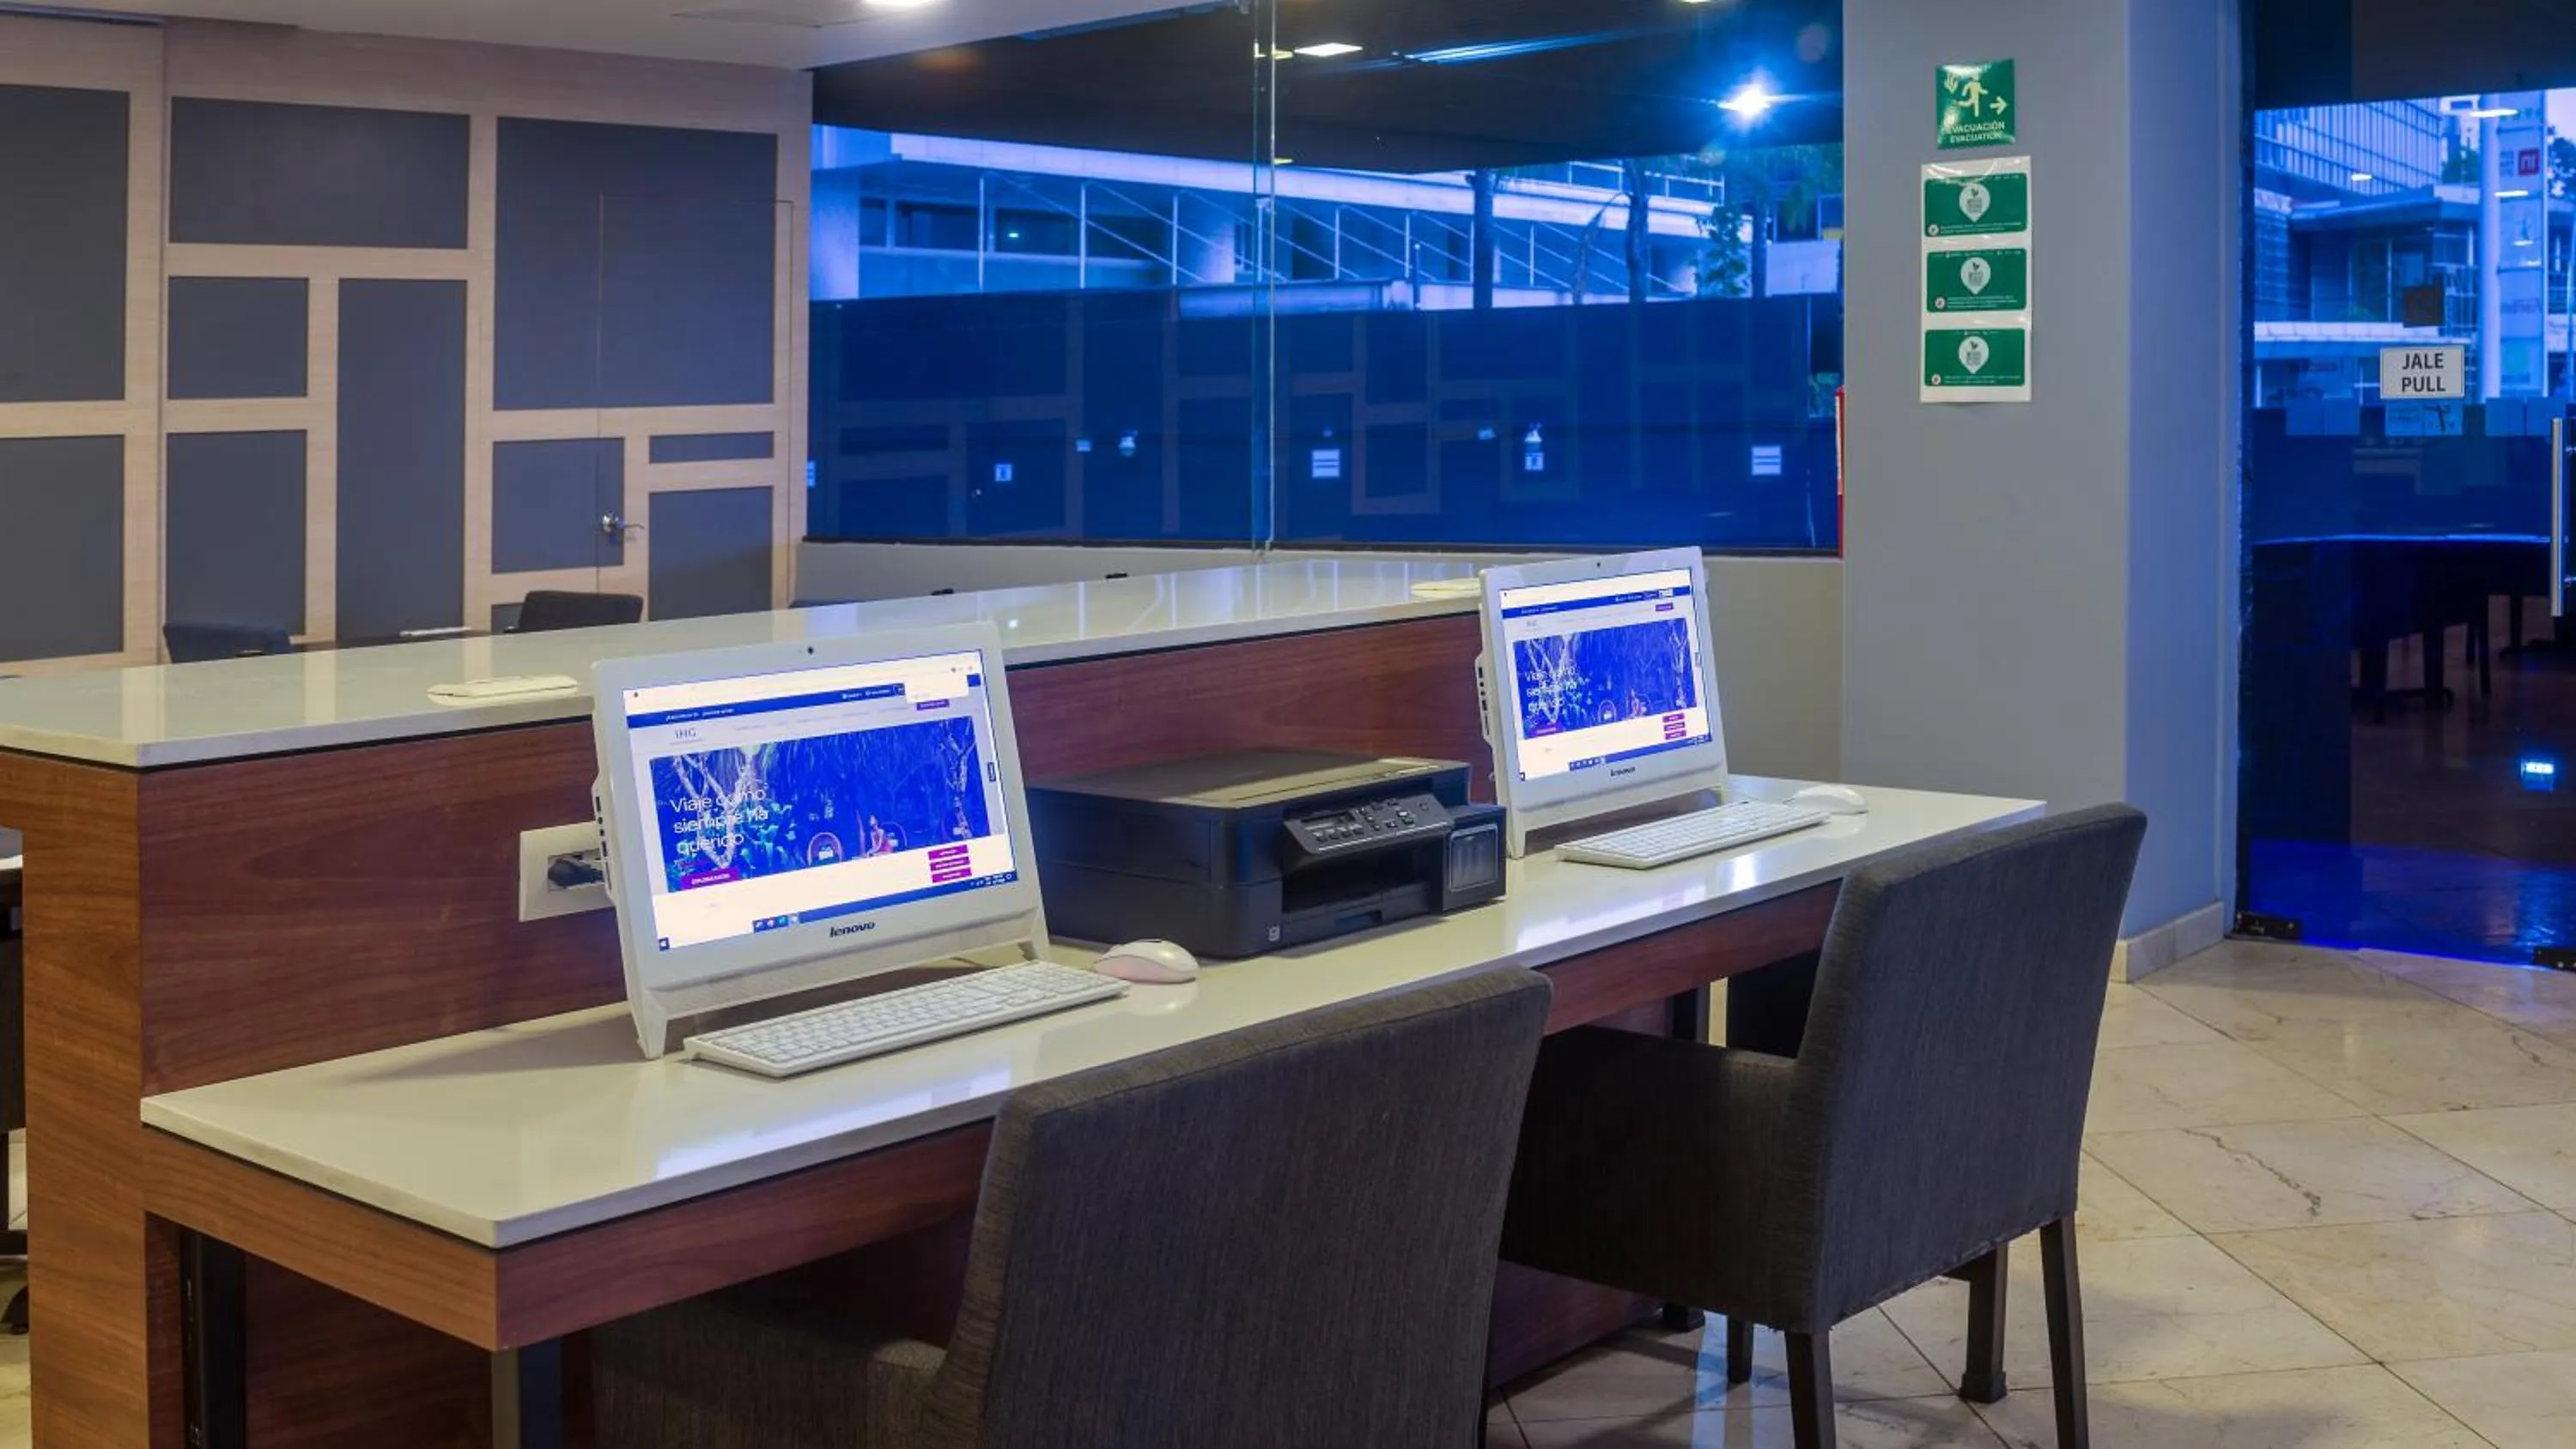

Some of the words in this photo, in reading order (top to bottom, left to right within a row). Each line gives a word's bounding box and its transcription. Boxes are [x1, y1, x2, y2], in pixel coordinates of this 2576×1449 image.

[1947, 120, 2005, 135] VACUACIÓN
[2402, 352, 2445, 370] JALE
[2402, 375, 2446, 393] PULL
[670, 797, 713, 814] Viaje
[829, 921, 876, 938] lenovo
